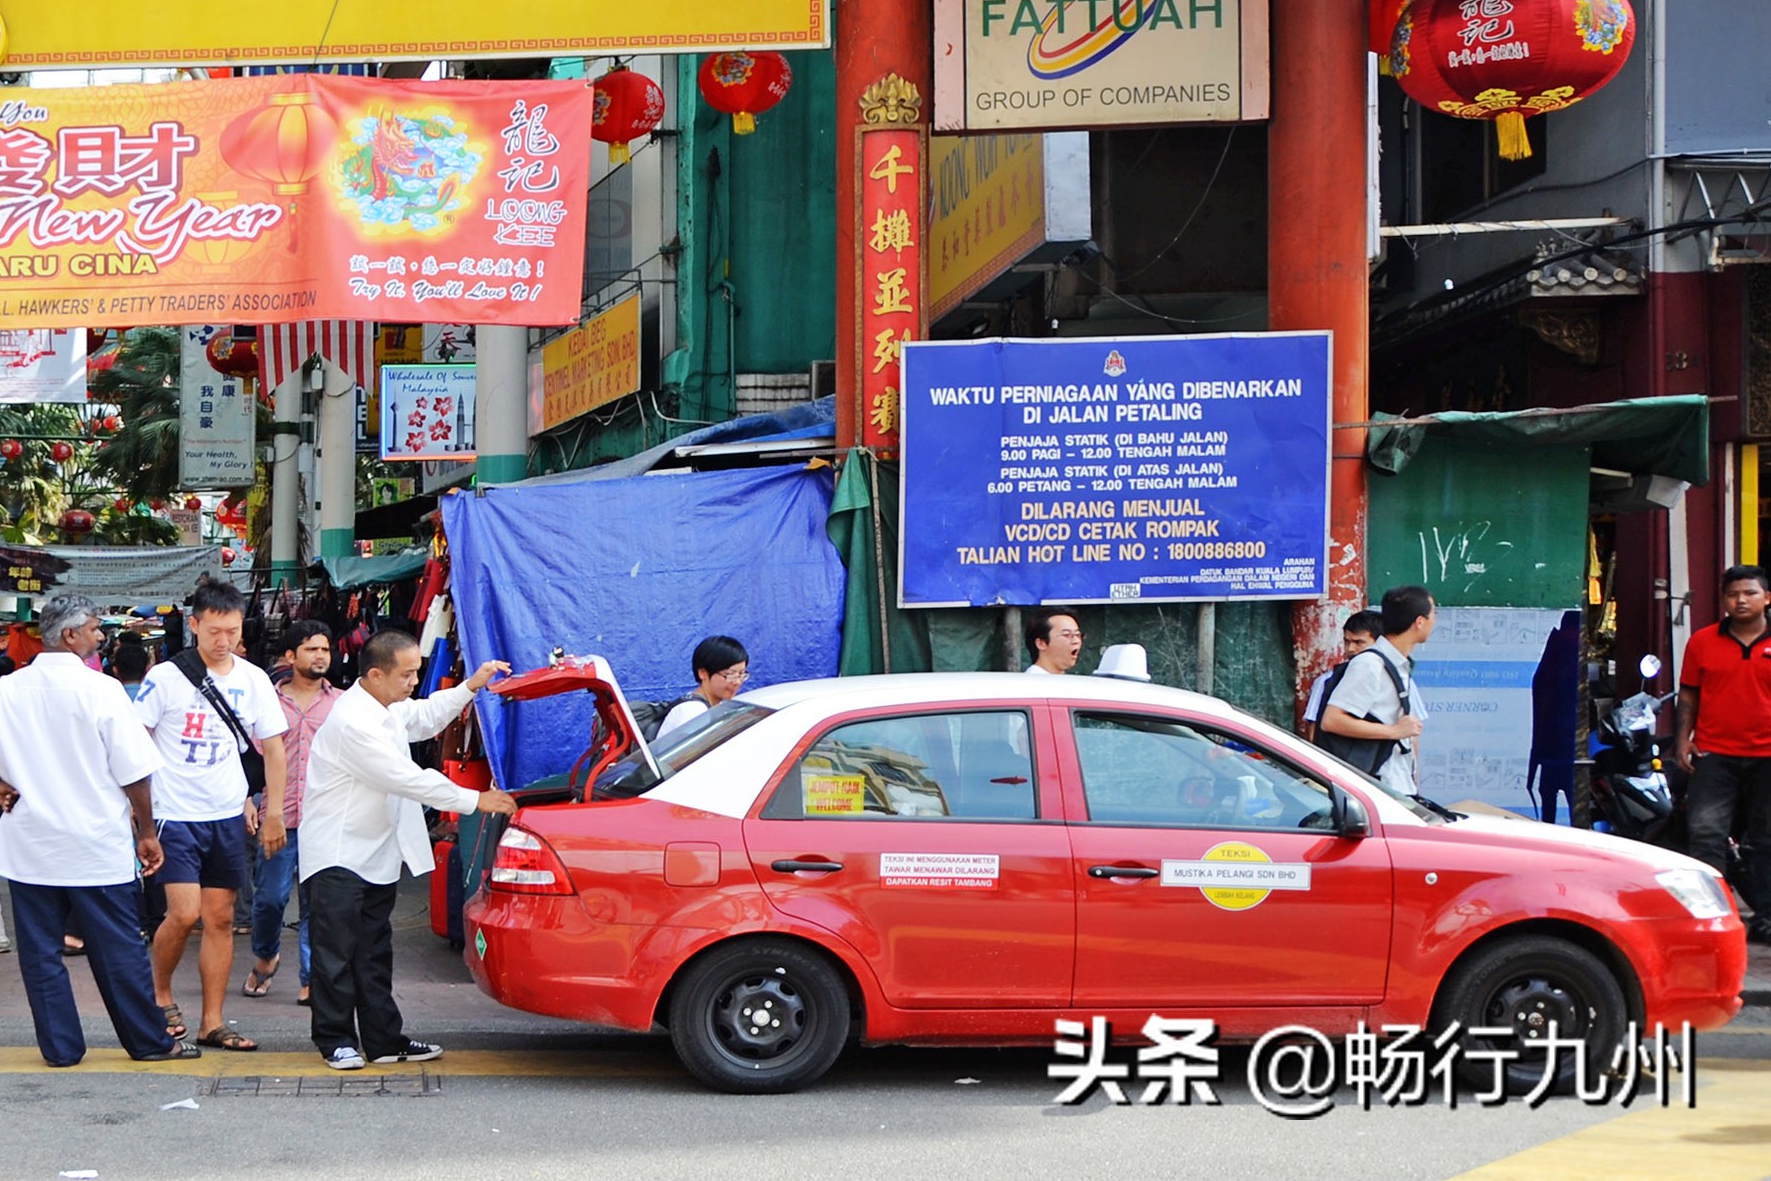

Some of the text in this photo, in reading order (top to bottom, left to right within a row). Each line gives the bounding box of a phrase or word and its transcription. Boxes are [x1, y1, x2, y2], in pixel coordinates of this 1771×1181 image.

[976, 83, 1230, 110] GROUP OF COMPANIES
[485, 199, 567, 224] LOONG
[116, 191, 282, 261] Year
[493, 223, 556, 247] KEE
[66, 253, 159, 276] CINA
[349, 279, 381, 301] Try
[465, 282, 506, 300] Love
[110, 296, 156, 313] PETTY
[232, 291, 318, 311] ASSOCIATION
[388, 371, 448, 383] Wholesale Of
[402, 383, 449, 396] Malaysia
[930, 379, 1302, 405] WAKTU PERNIAGAAN YANG DIBENARKAN
[1023, 402, 1202, 425] DI JALAN PETALING
[1001, 431, 1228, 448] PENJAJA STATIK (DI BAHU JALAN)
[185, 450, 204, 458] Your
[1001, 444, 1226, 462] 9.00 PAGI 12.00 TENGAH MALAM
[209, 461, 222, 469] My
[1001, 462, 1223, 479] PENJAJA STATIK (DI ATAS JALAN)
[987, 475, 1238, 494] 6.00 PETANG 12.00 TENGAH MALAM
[1021, 499, 1204, 520] DILARANG MENJUAL
[1005, 519, 1220, 543] VCD/CD CETAK ROMPAK
[957, 541, 1266, 565] TALIAN HOT LINE NO 1800886800
[1283, 558, 1315, 566] ARAHAN
[816, 799, 853, 812] WELCOME
[972, 857, 996, 865] METER
[1221, 849, 1251, 858] TEKSI
[913, 866, 953, 874] MENAWAR
[955, 867, 995, 875] DILARANG
[1174, 869, 1296, 880] MUSTIKA PELANGI SDN BHD
[886, 878, 928, 886] DAPATKAN
[954, 879, 993, 887] TAMBANG
